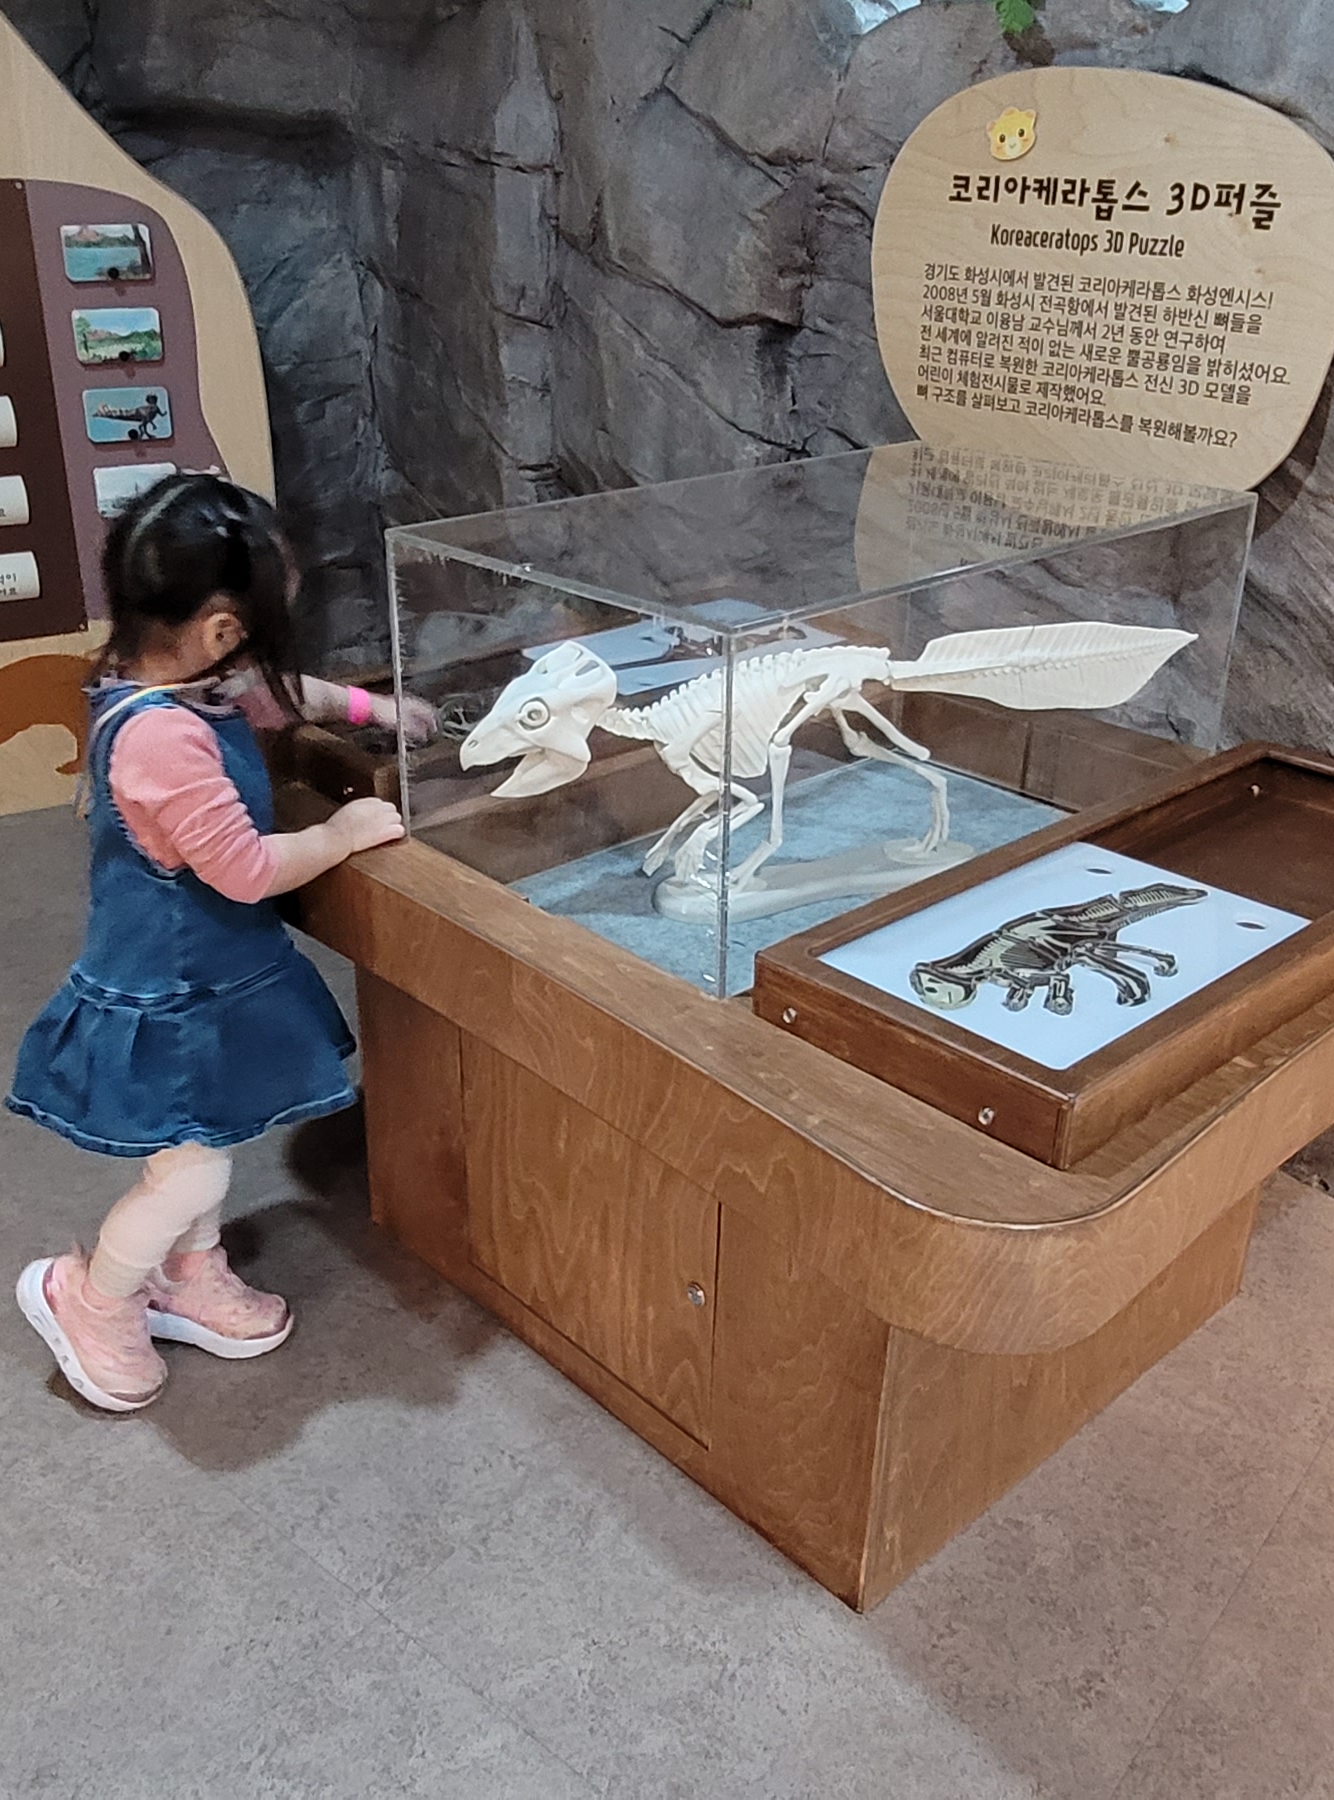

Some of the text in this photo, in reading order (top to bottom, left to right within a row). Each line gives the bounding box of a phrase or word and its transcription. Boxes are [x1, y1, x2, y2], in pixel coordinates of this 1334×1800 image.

[948, 174, 1282, 231] 코리아케라톱스 3D퍼즐
[990, 222, 1185, 258] Koreaceratops 3D Puzzle
[922, 284, 1263, 336] 2008년 5월 화성시 전곡항에서 발견된 하반신 뼈들을
[924, 263, 1274, 310] 경기도 화성시에서 발견된 코리아케라톱스 화성엔시스!
[920, 324, 1290, 386] 전 세계에 알려진 적이 없는 새로운 뿔공룡임을 밝히셨어요.
[921, 303, 1226, 355] 서울대학교 이용남 교수님께서 2년 동안 연구하여
[917, 364, 1107, 407] 어린이 체험전시물로 제작했어요.
[919, 344, 1252, 406] 최근 컴퓨터로 복원한 코리아케라톱스 전신 3D 모델을
[916, 384, 1238, 448] 뼈 구조를 살펴보고 코리아케라톱스를 복원해볼까요?
